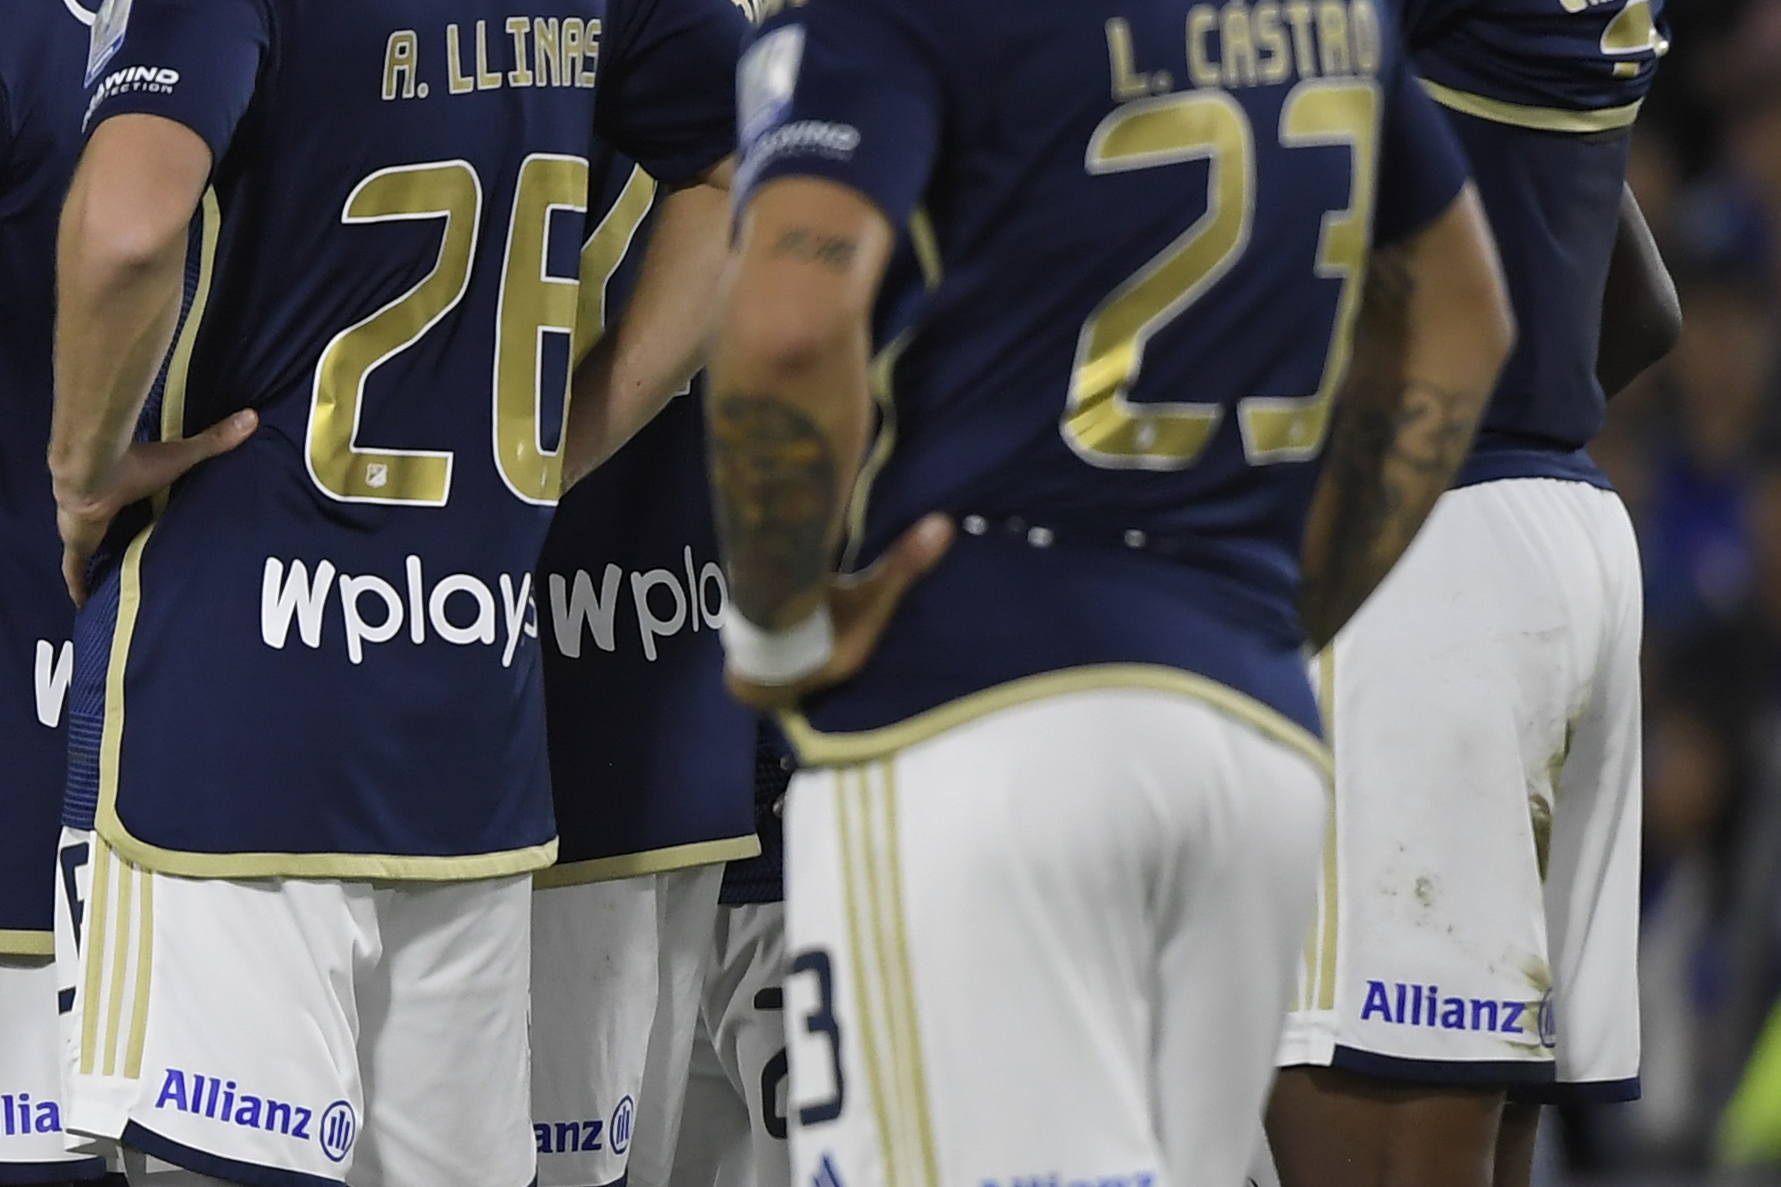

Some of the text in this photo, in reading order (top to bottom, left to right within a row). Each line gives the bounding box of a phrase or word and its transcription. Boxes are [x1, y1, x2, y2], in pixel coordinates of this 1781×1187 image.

[381, 16, 603, 101] A. LLINAS
[1105, 15, 1172, 100] L.
[1060, 74, 1383, 471] 23
[1360, 979, 1527, 1034] Allianz
[155, 1068, 312, 1140] Allianz
